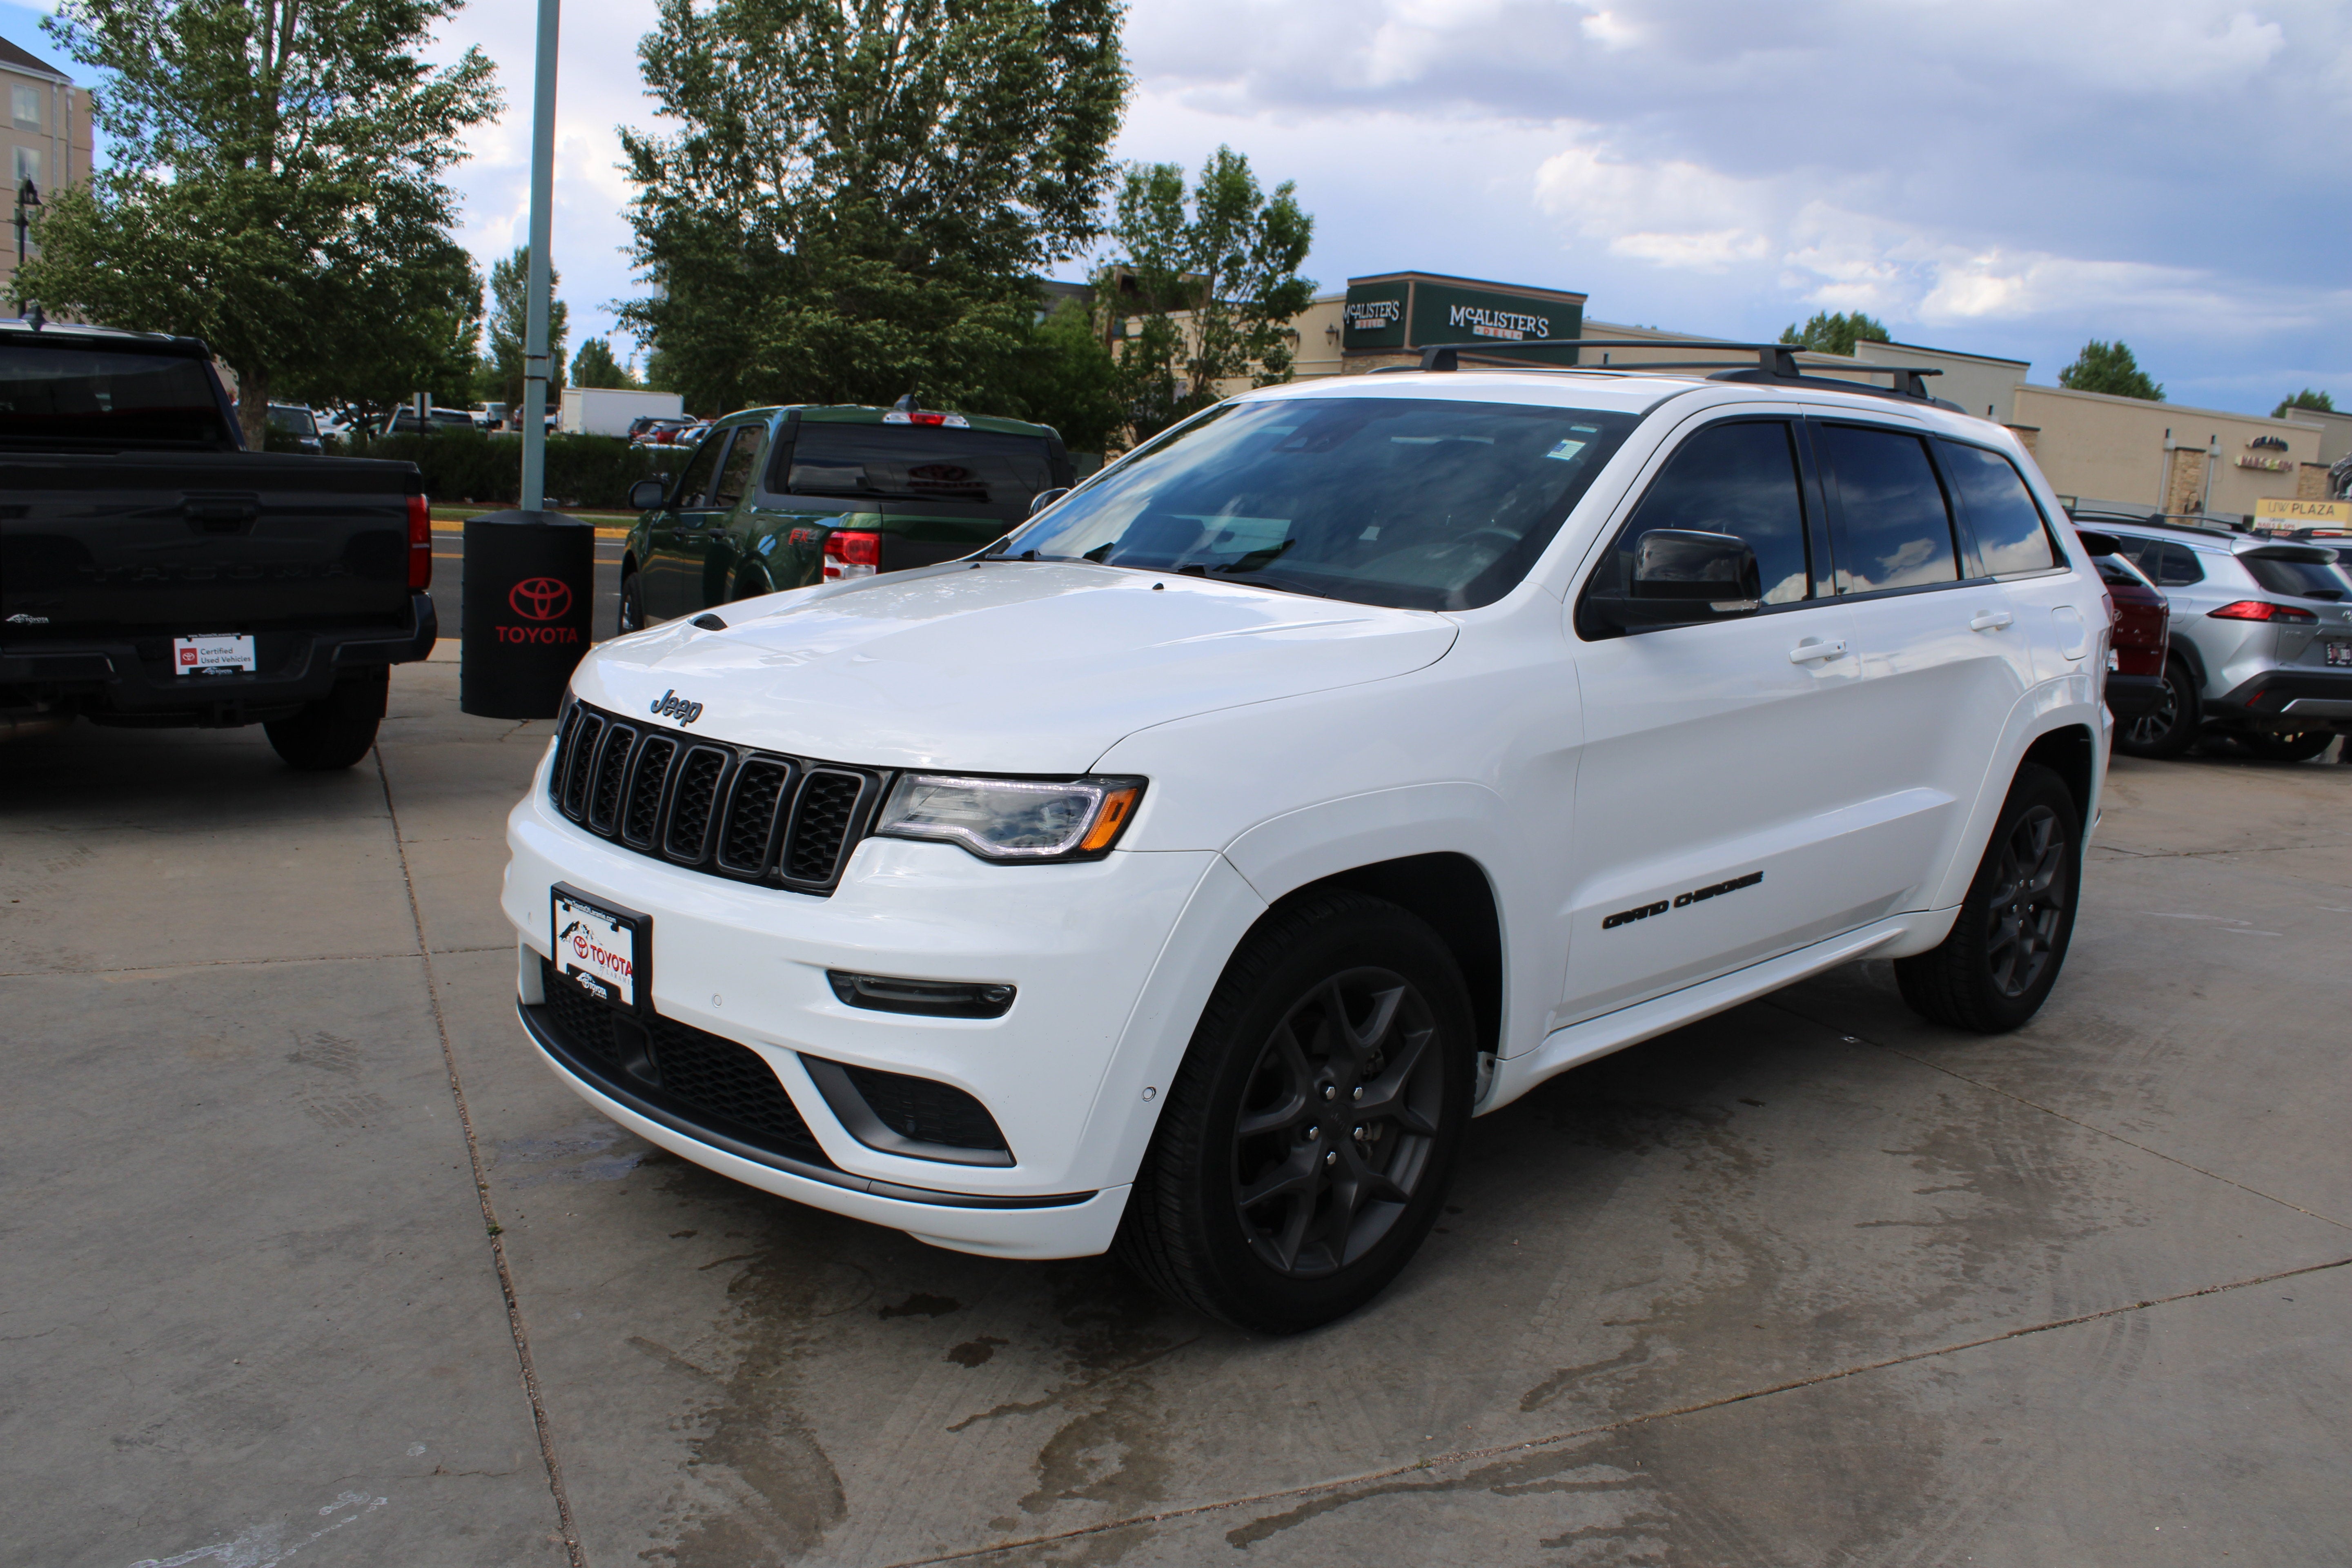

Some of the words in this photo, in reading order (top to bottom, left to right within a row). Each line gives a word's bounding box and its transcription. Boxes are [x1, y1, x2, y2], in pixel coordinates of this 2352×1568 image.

[1483, 327, 1514, 338] DELI
[2268, 501, 2290, 513] UW
[2292, 502, 2335, 516] PLAZA
[788, 528, 820, 546] FX4
[495, 626, 579, 644] TOYOTA
[650, 689, 703, 727] Jeep
[1602, 900, 1669, 929] GRAND
[1673, 871, 1764, 908] CHEROKEE
[590, 944, 633, 976] TOYOTA
[589, 981, 607, 996] TOYOTA
